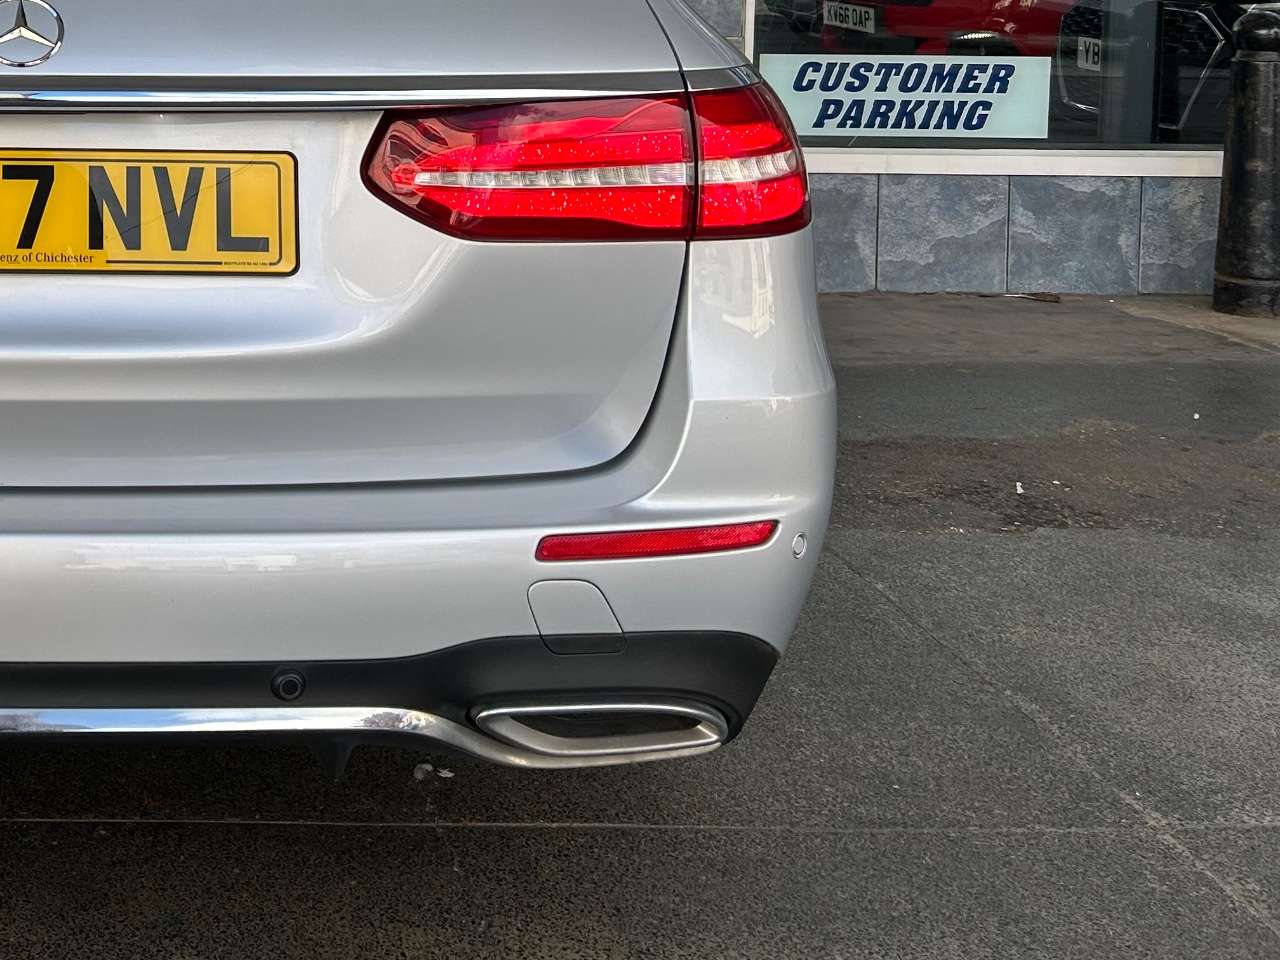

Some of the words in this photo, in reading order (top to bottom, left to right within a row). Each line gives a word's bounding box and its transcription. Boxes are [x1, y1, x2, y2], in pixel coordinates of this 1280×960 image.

[792, 61, 1016, 94] CUSTOMER
[812, 99, 993, 131] PARKING
[88, 165, 270, 253] NVL
[22, 252, 33, 263] of
[35, 252, 94, 264] Chichester
